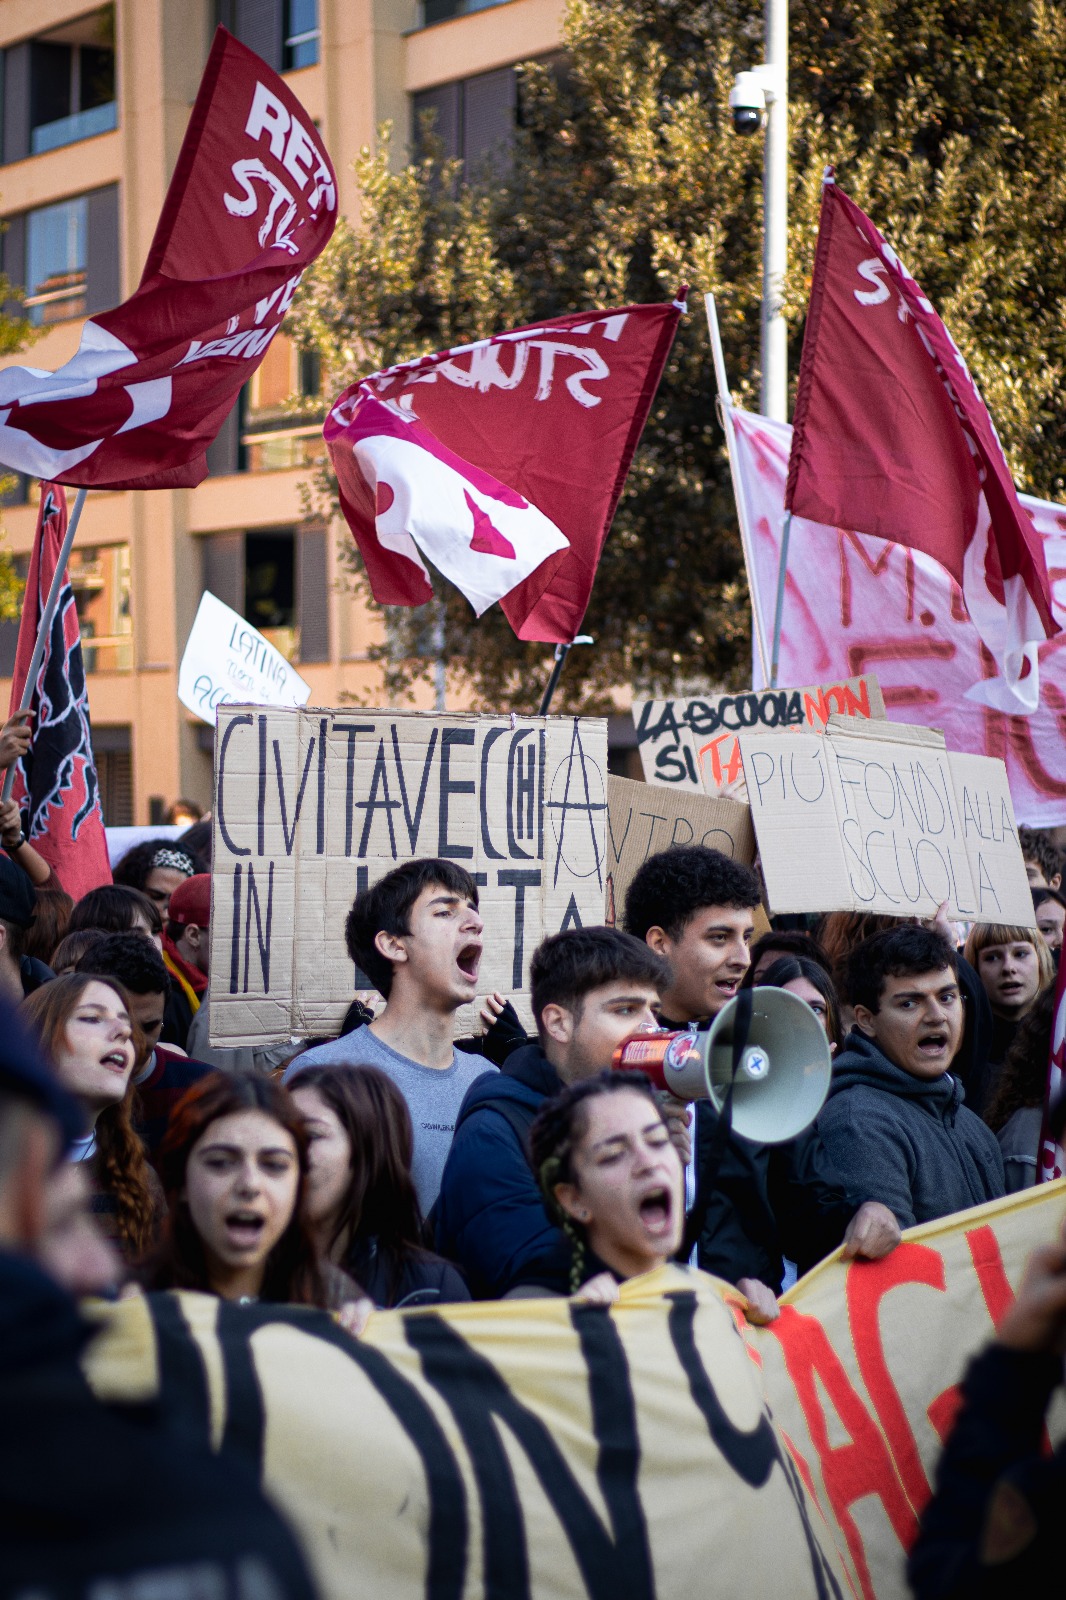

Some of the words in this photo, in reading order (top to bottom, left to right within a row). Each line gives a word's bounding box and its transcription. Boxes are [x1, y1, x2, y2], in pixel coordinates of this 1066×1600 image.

[229, 622, 287, 693] LATINA
[803, 679, 871, 727] NON
[654, 744, 698, 784] SI
[217, 714, 608, 892] CIVITAVECCHIA
[963, 786, 1020, 848] ALLA
[843, 818, 1001, 914] SCUOLA
[229, 861, 275, 995] IN
